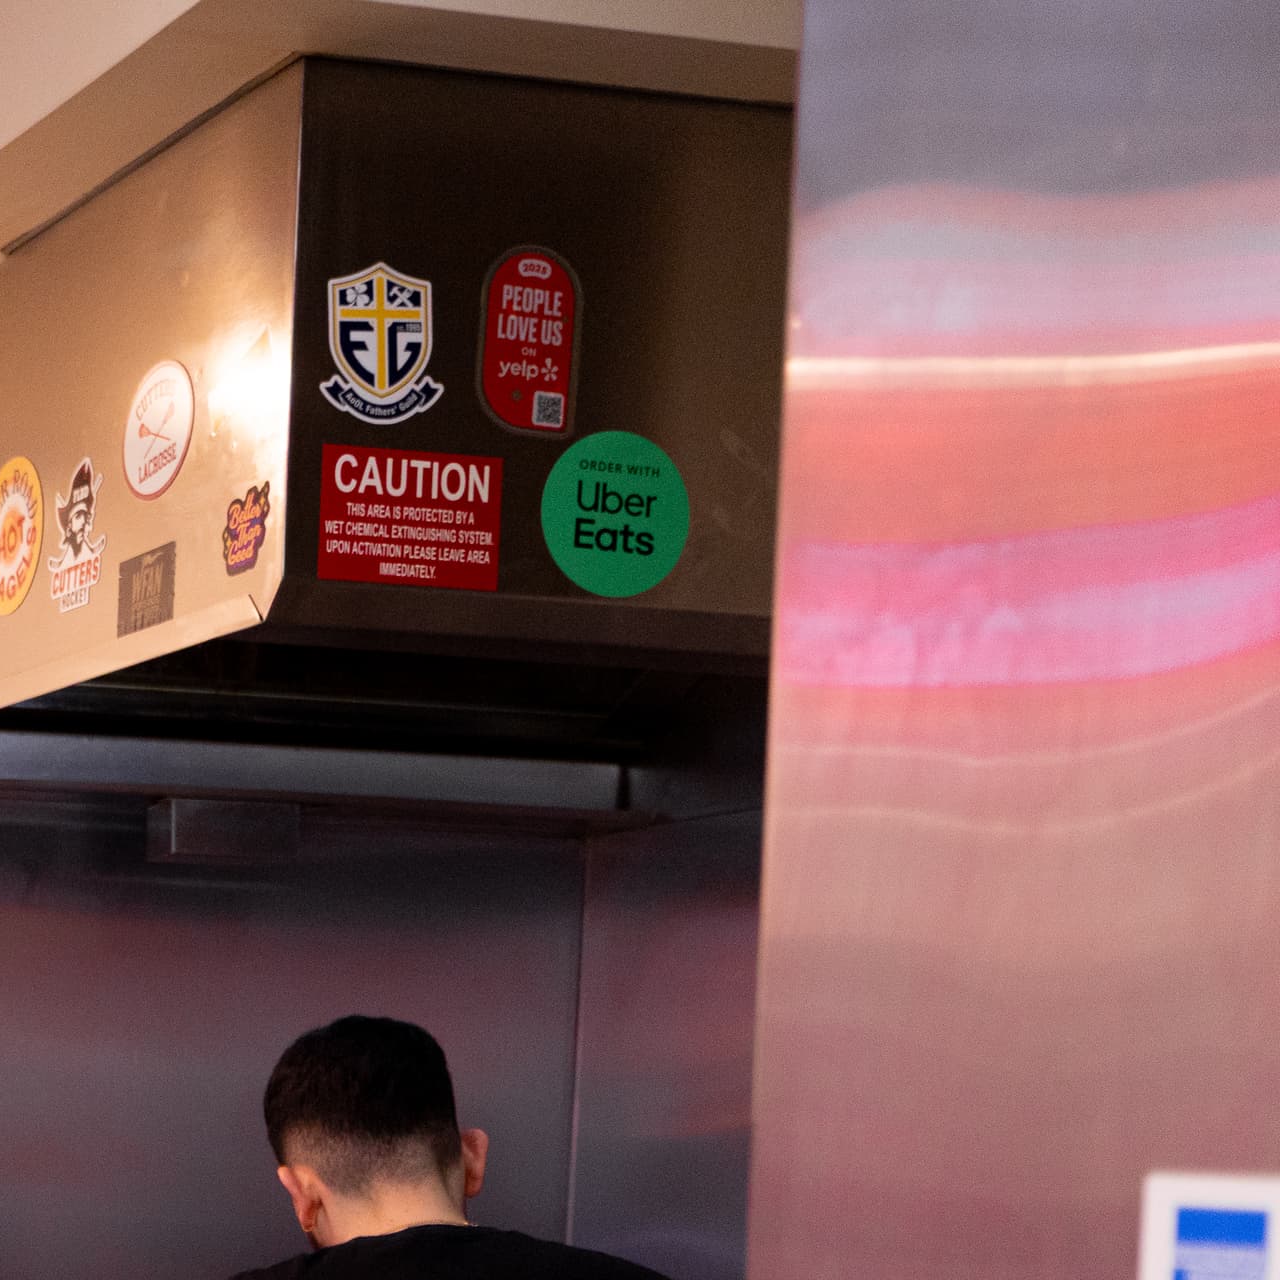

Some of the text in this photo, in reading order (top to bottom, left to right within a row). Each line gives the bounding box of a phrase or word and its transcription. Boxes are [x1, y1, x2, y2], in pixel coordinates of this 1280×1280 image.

[502, 284, 562, 316] PEOPLE
[497, 313, 562, 346] LOVE US
[521, 347, 536, 356] ON
[498, 359, 539, 381] yelp
[138, 441, 177, 484] LACROSSE
[579, 459, 660, 478] ORDER WITH
[334, 453, 491, 503] CAUTION
[577, 480, 657, 518] Uber
[346, 502, 474, 525] THIS AREA IS PROTECTED BY A
[325, 520, 494, 545] WET CHEMICAL EXTINGUISHING SYSTEM.
[574, 517, 654, 556] Eats
[326, 540, 490, 564] UPON ACTIVATION PLEASE LEAVE AREA
[52, 557, 100, 595] CUTTERS
[379, 562, 436, 579] IMMEDIATELY.
